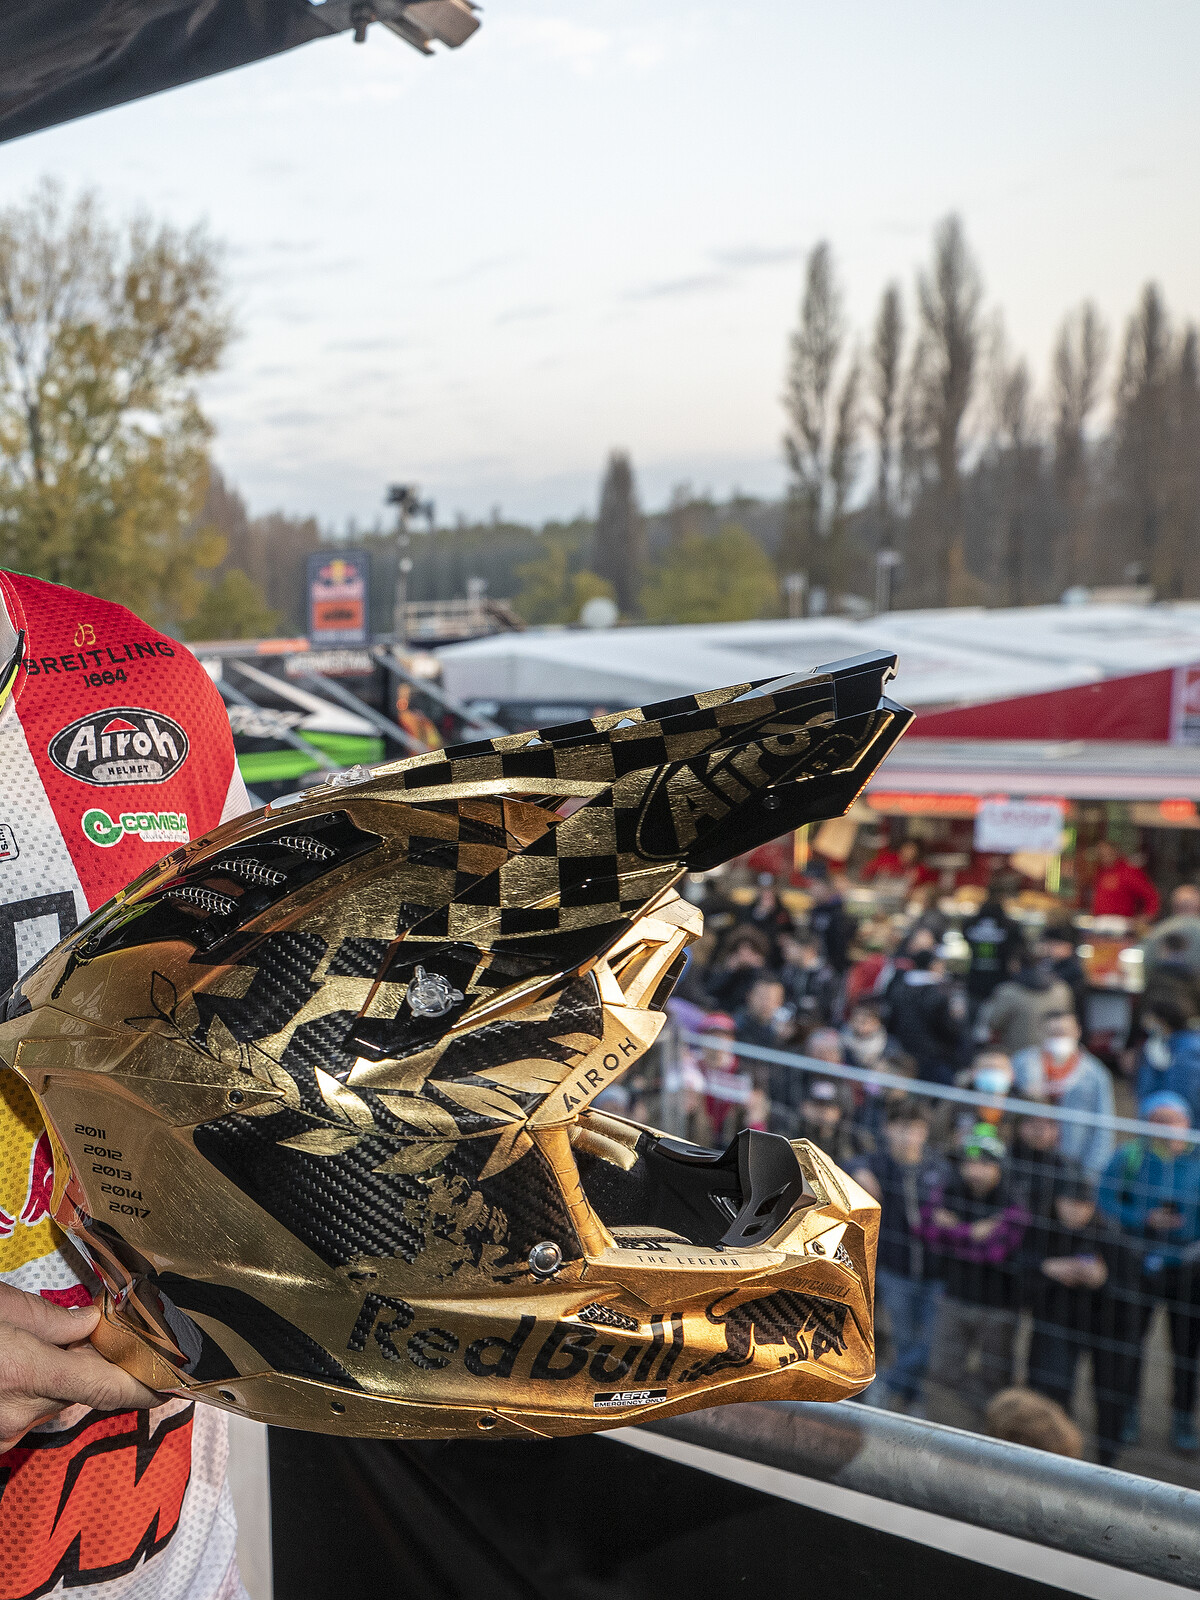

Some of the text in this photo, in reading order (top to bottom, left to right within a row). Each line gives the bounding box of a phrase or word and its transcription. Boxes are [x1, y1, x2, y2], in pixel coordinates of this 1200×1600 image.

[22, 641, 175, 676] BREITLING
[82, 668, 128, 688] 1884
[65, 717, 179, 769] Airoh
[107, 764, 150, 776] HELMET
[121, 813, 188, 832] COMISA
[563, 1037, 638, 1113] AIROH
[74, 1123, 106, 1140] 2011
[83, 1143, 123, 1161] 2012
[92, 1162, 133, 1181] 2013
[101, 1182, 143, 1201] 2014
[109, 1201, 151, 1219] 2017
[637, 1255, 667, 1264] THE
[346, 1292, 686, 1384] Red Bull
[594, 1400, 644, 1408] EMERGENCY
[611, 1391, 651, 1401] AEFR
